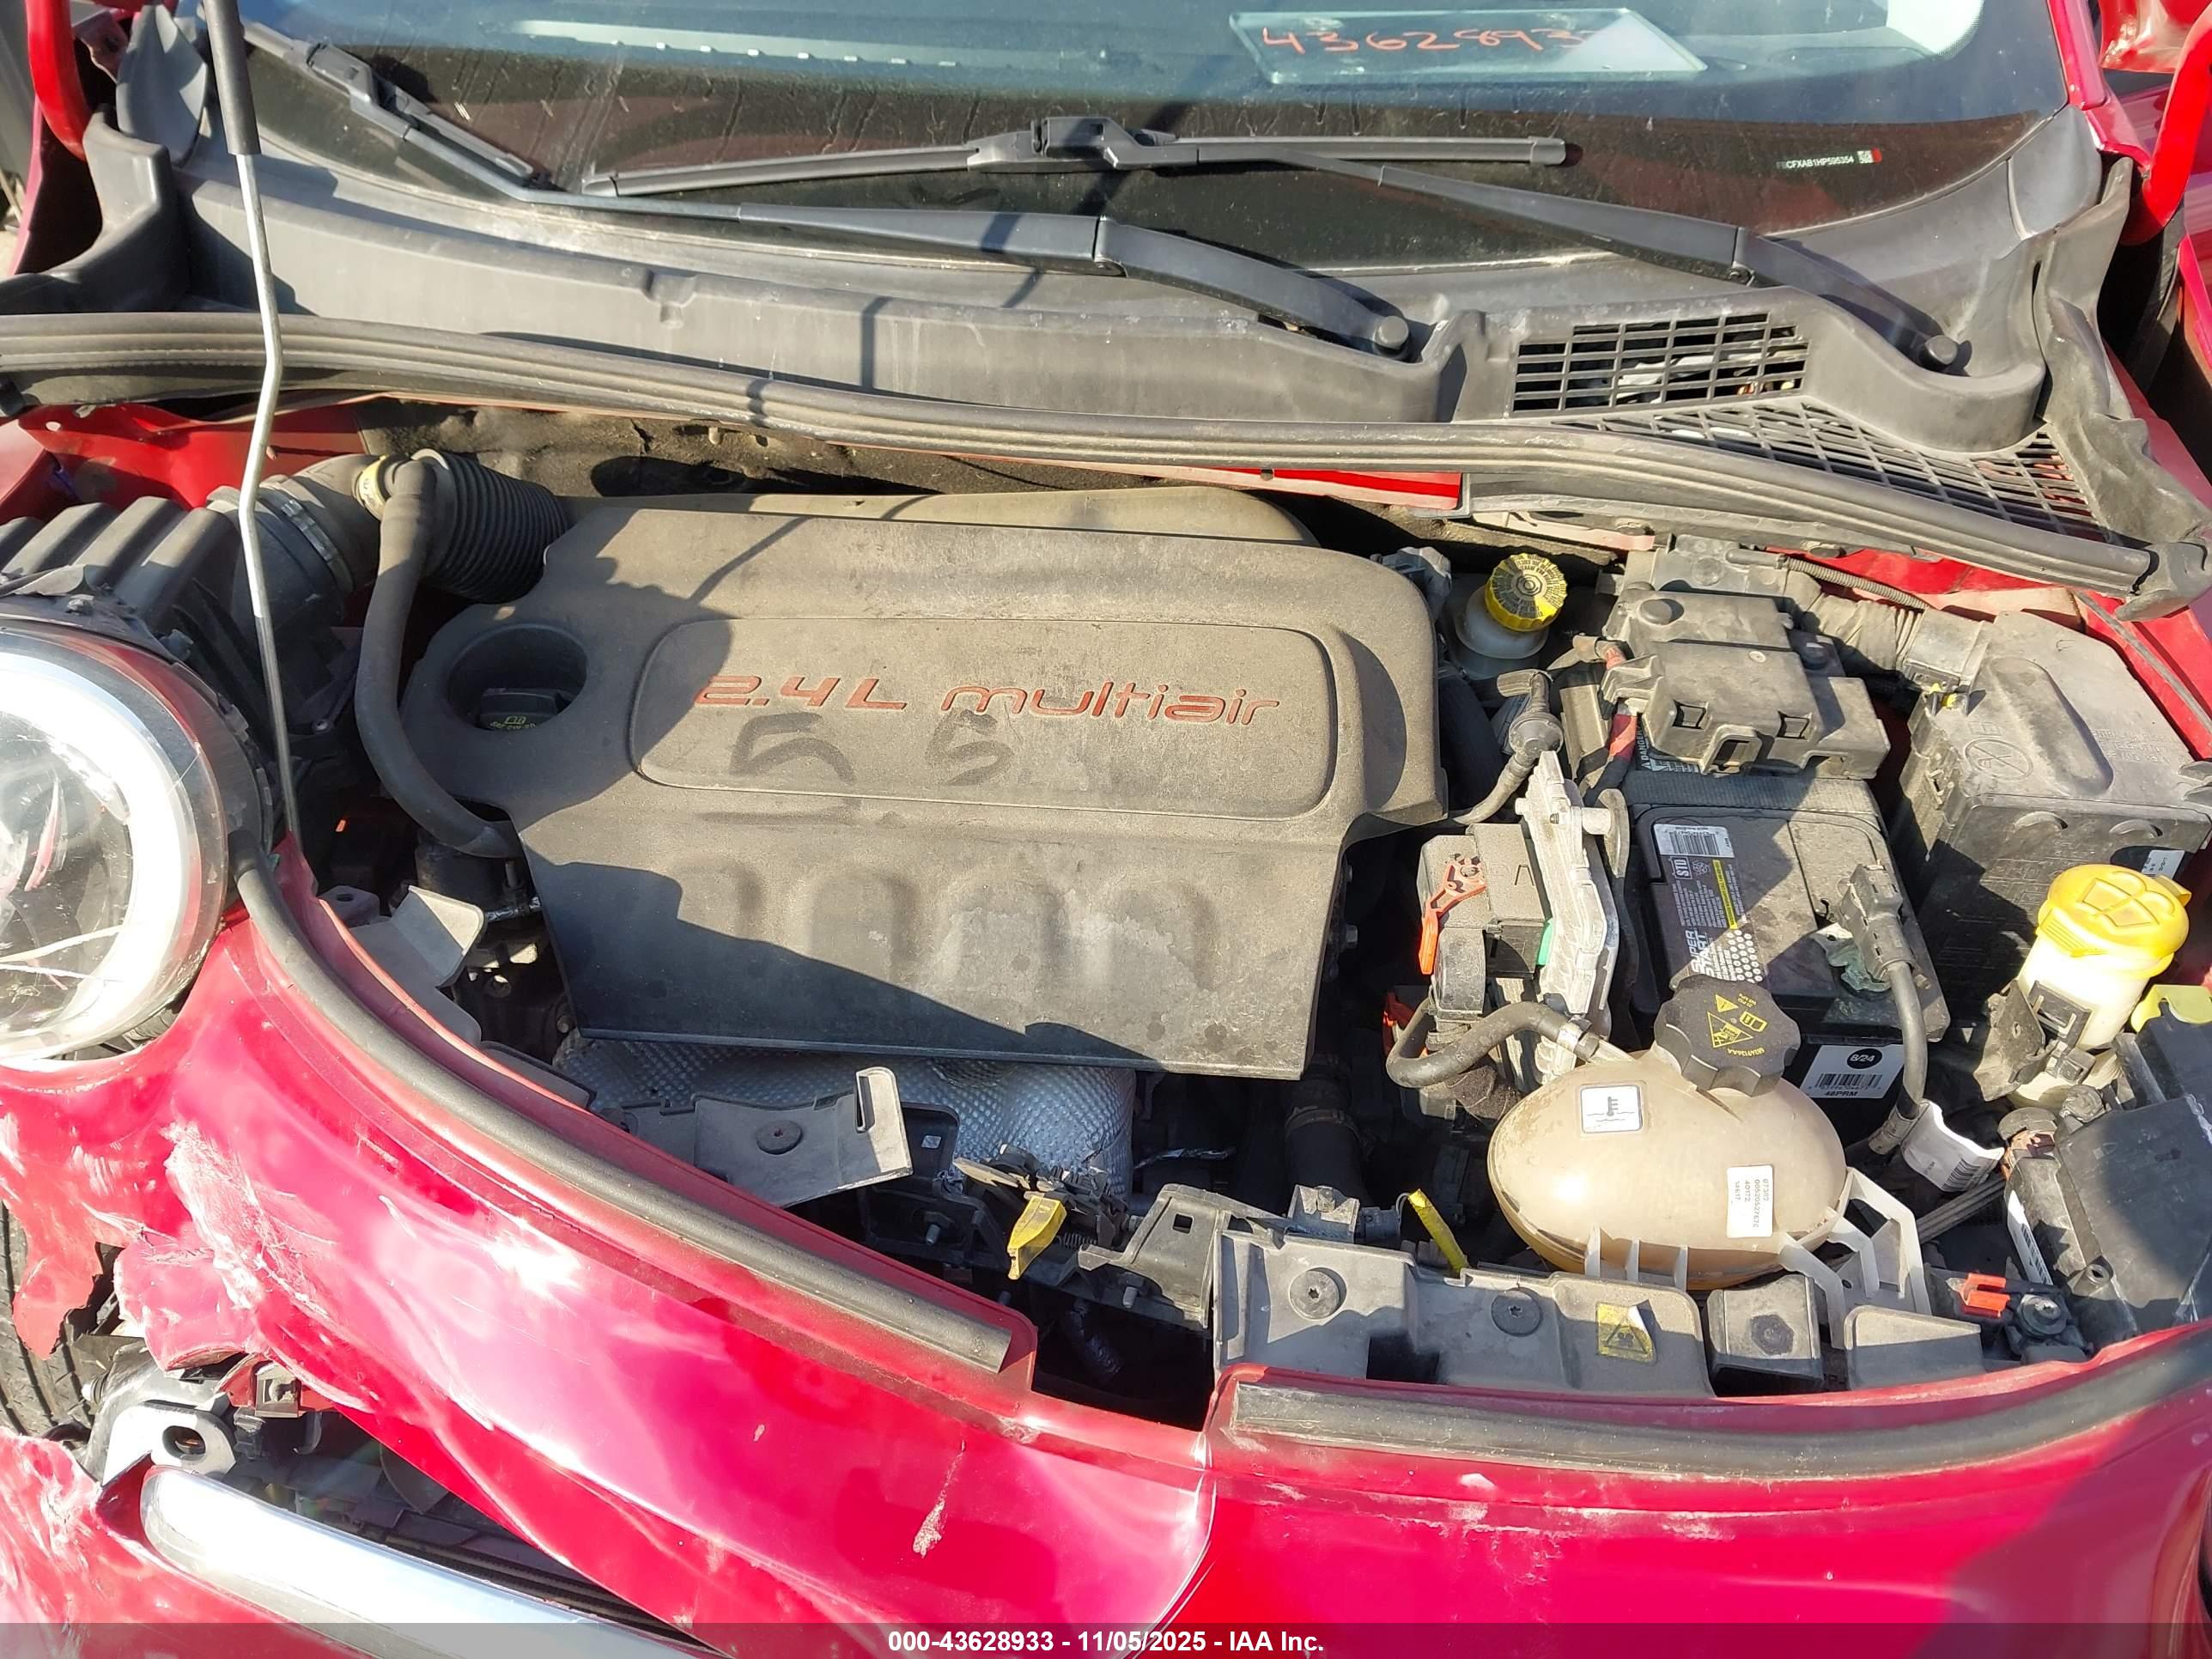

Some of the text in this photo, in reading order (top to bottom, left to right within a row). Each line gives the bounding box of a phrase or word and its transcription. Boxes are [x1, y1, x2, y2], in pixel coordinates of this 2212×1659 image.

[1262, 27, 1597, 55] 4362893
[939, 681, 1280, 726] multiair
[1686, 930, 1705, 975] SUPER
[1694, 929, 1716, 977] START
[1850, 1054, 1875, 1062] 8/24
